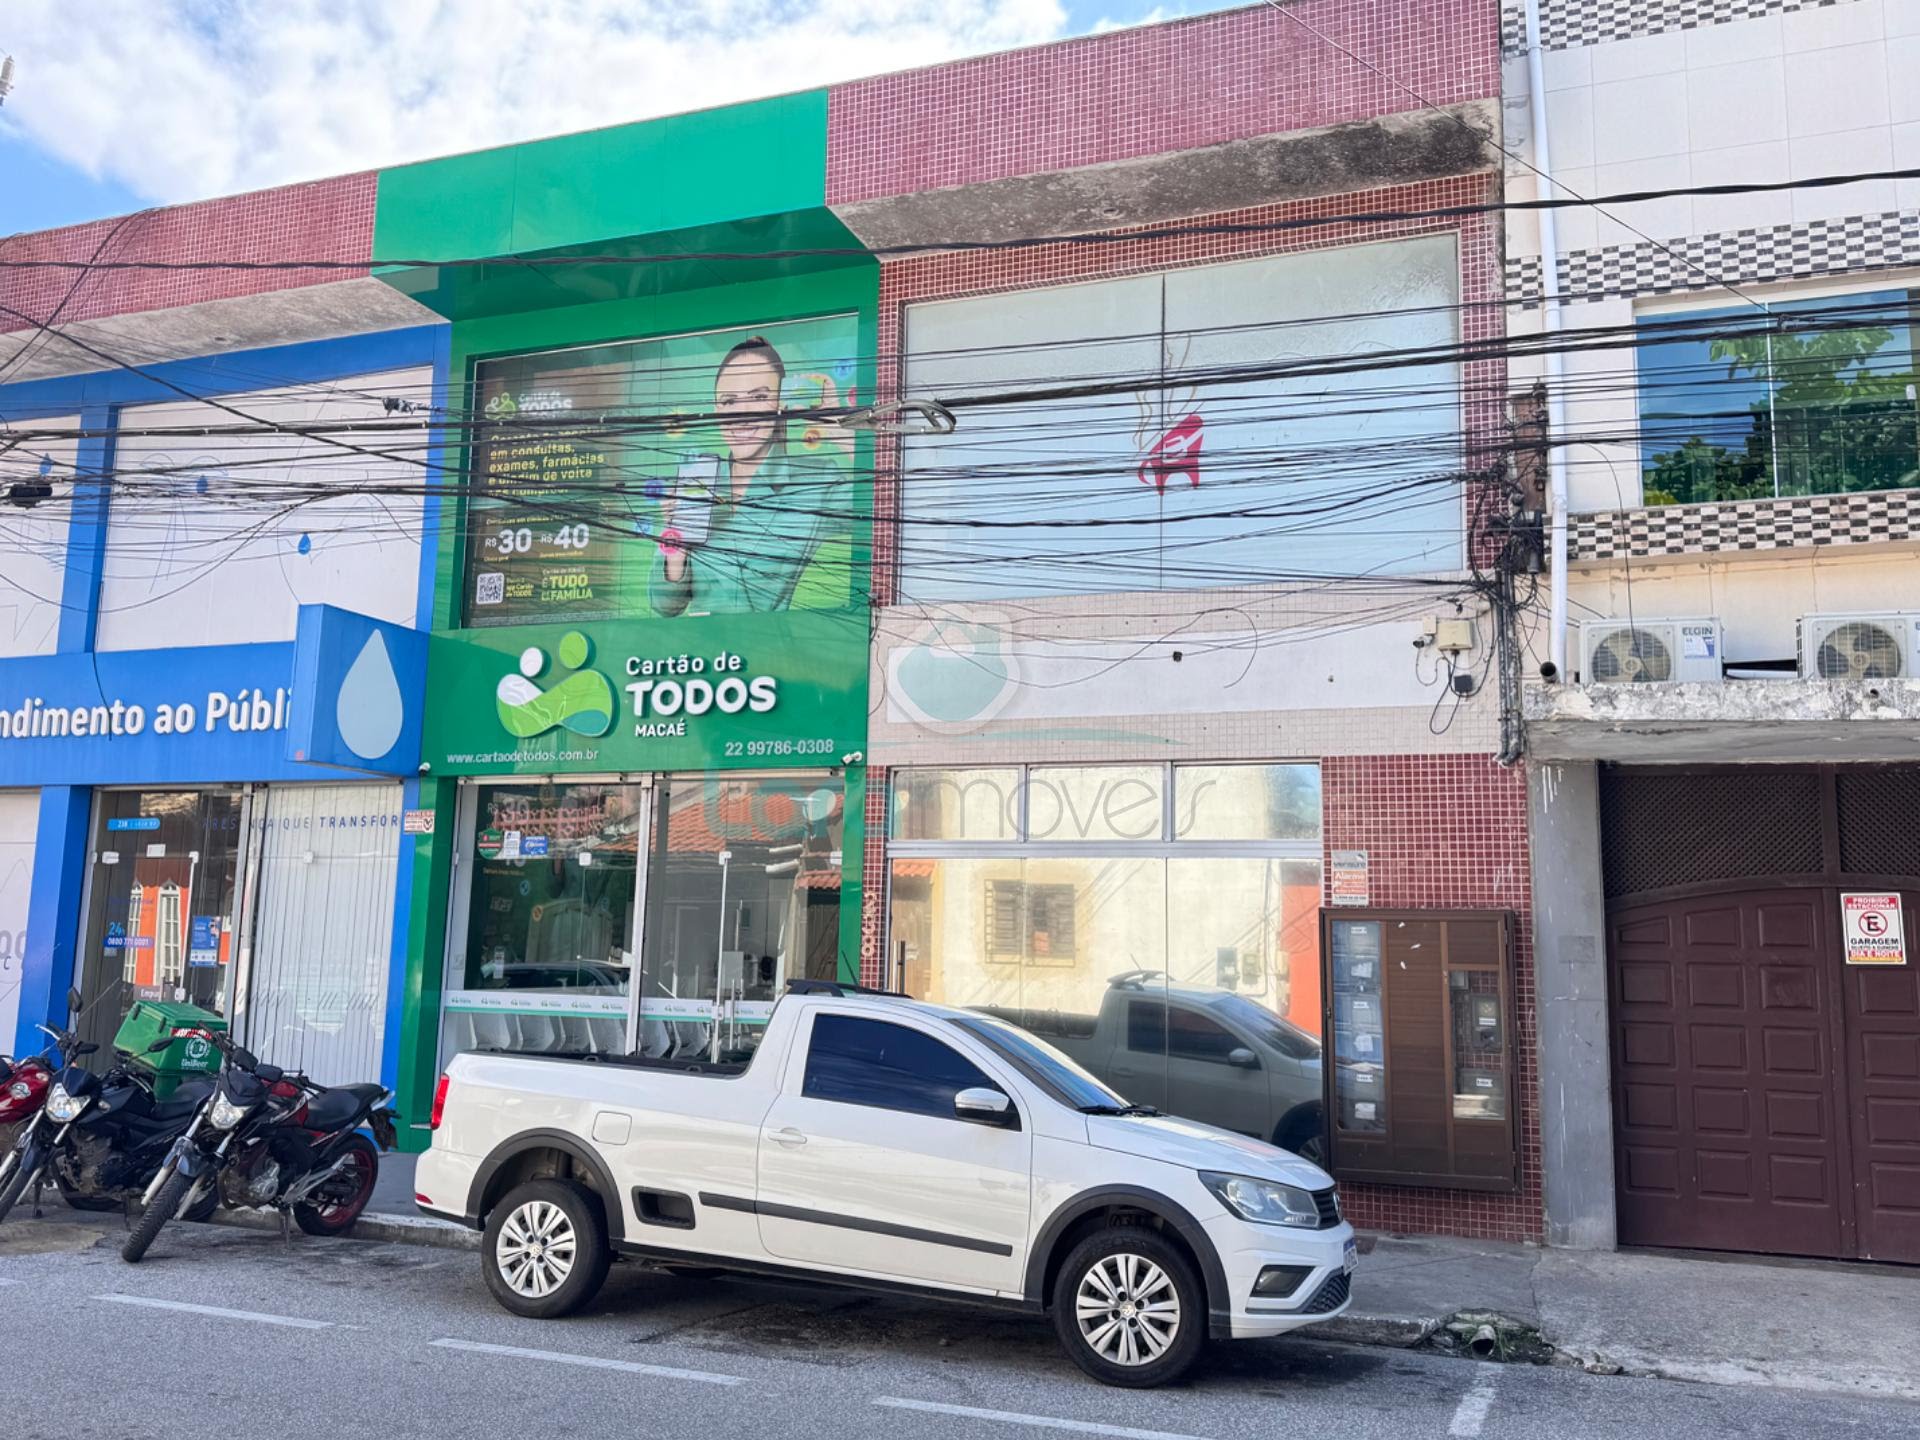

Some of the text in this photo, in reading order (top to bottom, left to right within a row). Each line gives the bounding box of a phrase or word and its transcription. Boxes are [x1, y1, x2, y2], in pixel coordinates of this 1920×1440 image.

[489, 453, 605, 473] exames, farmácias
[561, 467, 593, 479] volta
[485, 527, 532, 554] R$ 30
[540, 523, 590, 550] R$ 40
[550, 574, 589, 588] TUDO
[551, 587, 593, 601] FAMÍLIA
[1682, 626, 1713, 636] ELGIN
[626, 651, 741, 676] Cartão de
[625, 675, 777, 717] TODOS
[153, 702, 196, 735] ao
[634, 719, 687, 737] MACAÉ
[447, 748, 599, 764] www.cartaodetodos.com.br
[724, 739, 834, 756] 22 99786-0308
[282, 816, 311, 831] QUE
[319, 814, 399, 829] TRANSFOR
[1850, 937, 1899, 945] GARAGEM
